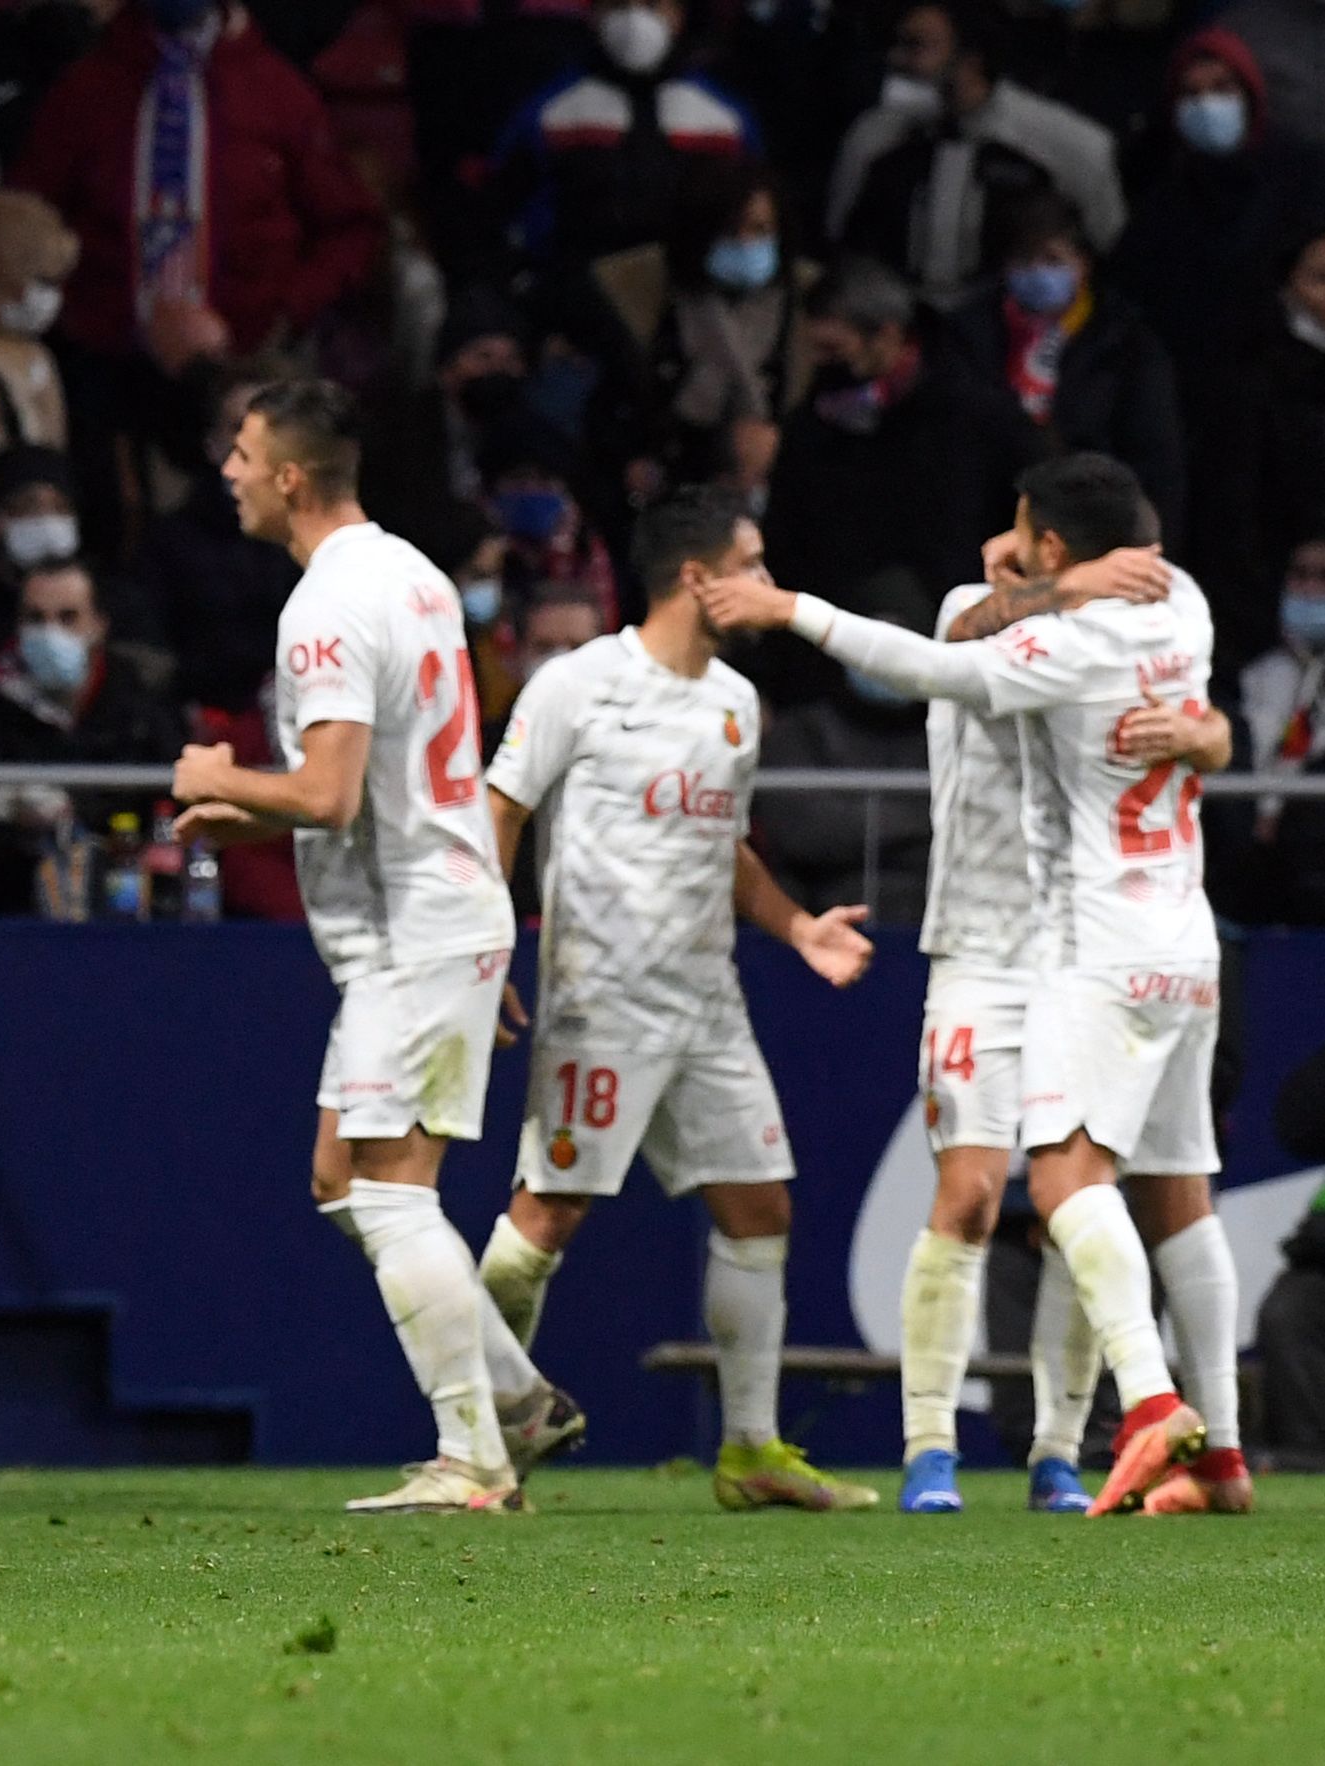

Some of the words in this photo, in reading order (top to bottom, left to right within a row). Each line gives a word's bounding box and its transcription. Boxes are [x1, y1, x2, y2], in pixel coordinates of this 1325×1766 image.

[288, 637, 342, 676] OK
[417, 647, 482, 808] 2
[928, 1027, 975, 1087] 14
[557, 1062, 618, 1129] 18
